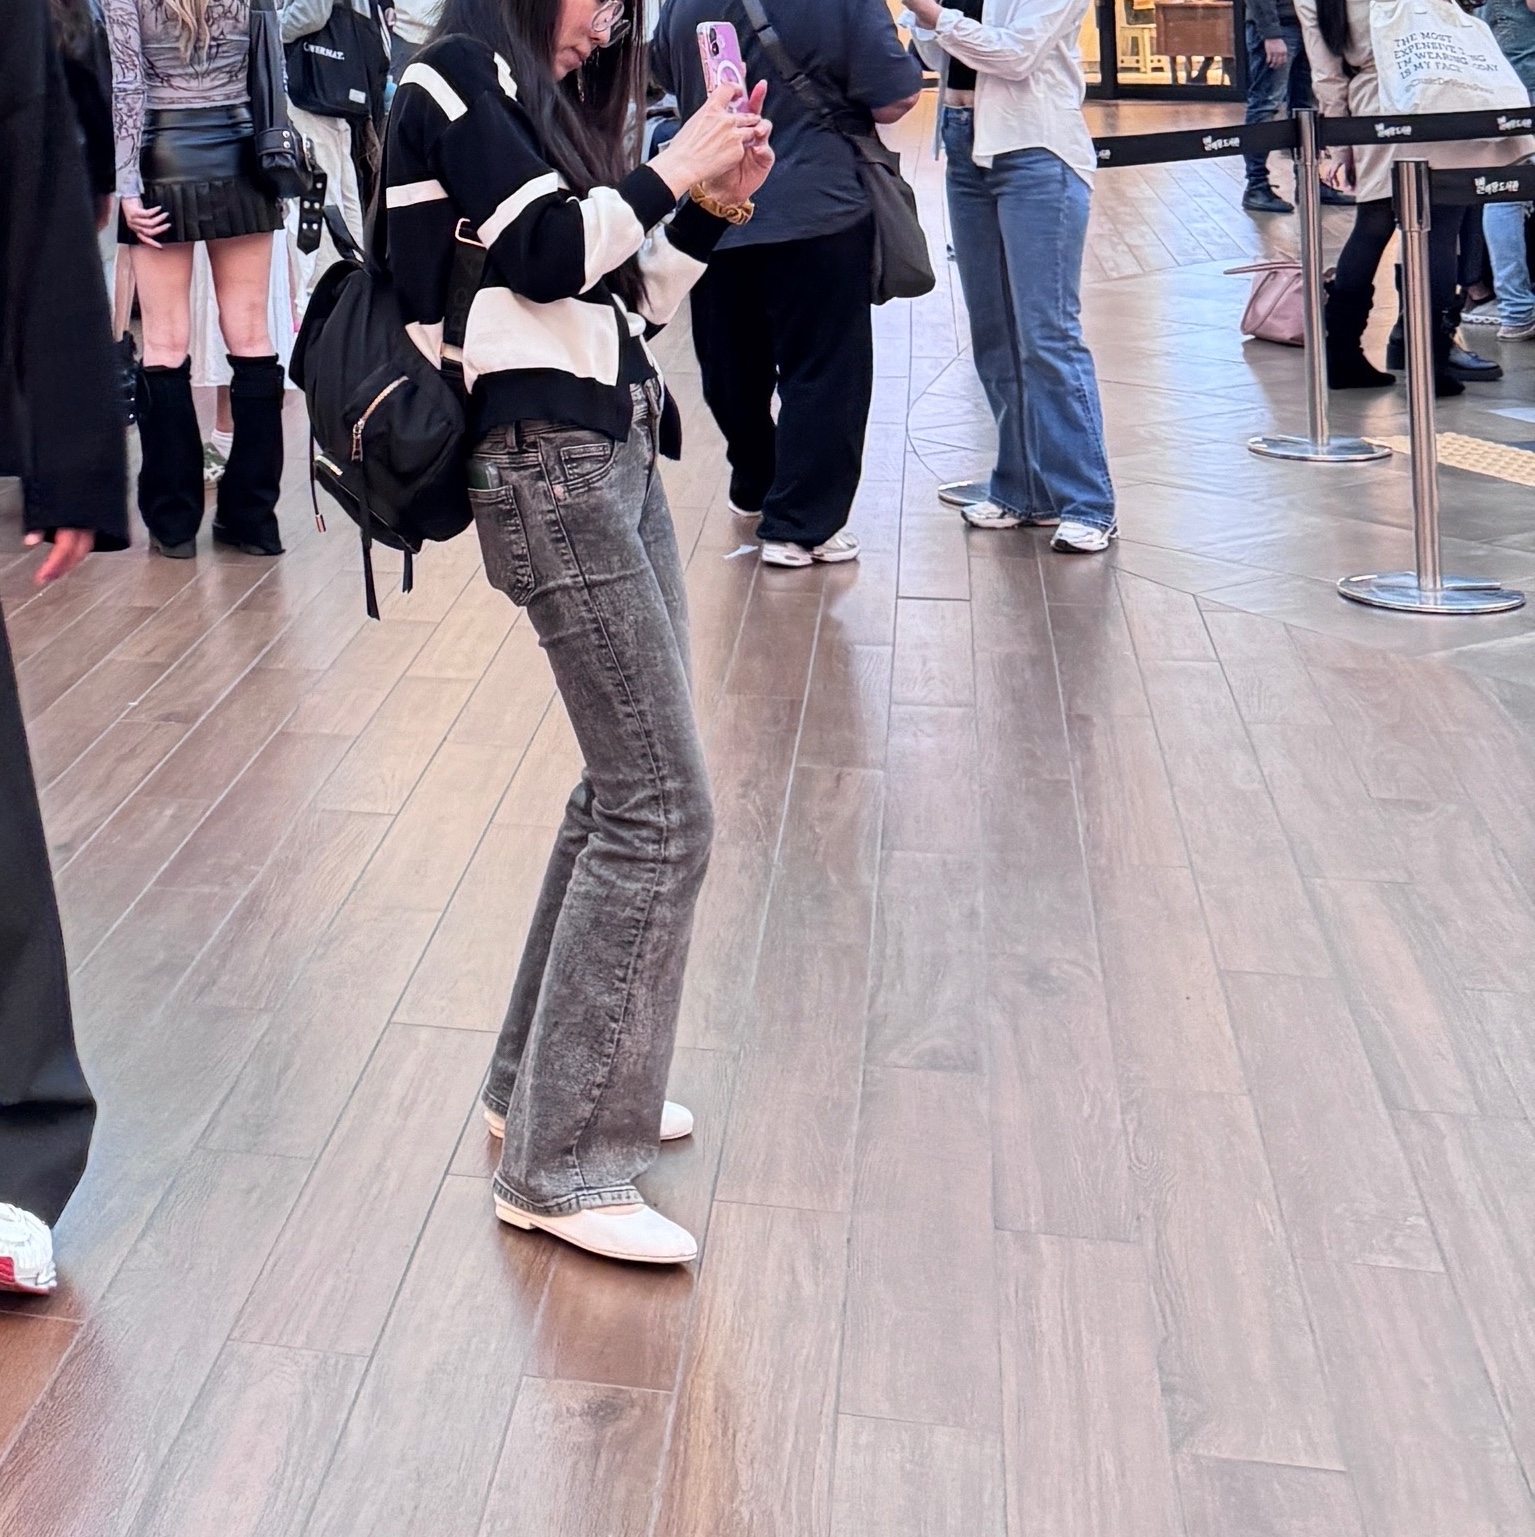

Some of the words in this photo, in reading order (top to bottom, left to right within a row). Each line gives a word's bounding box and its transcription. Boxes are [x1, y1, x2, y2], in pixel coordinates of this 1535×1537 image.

[1394, 33, 1418, 48] THE
[1421, 31, 1453, 43] MOST
[1413, 60, 1431, 73] MY
